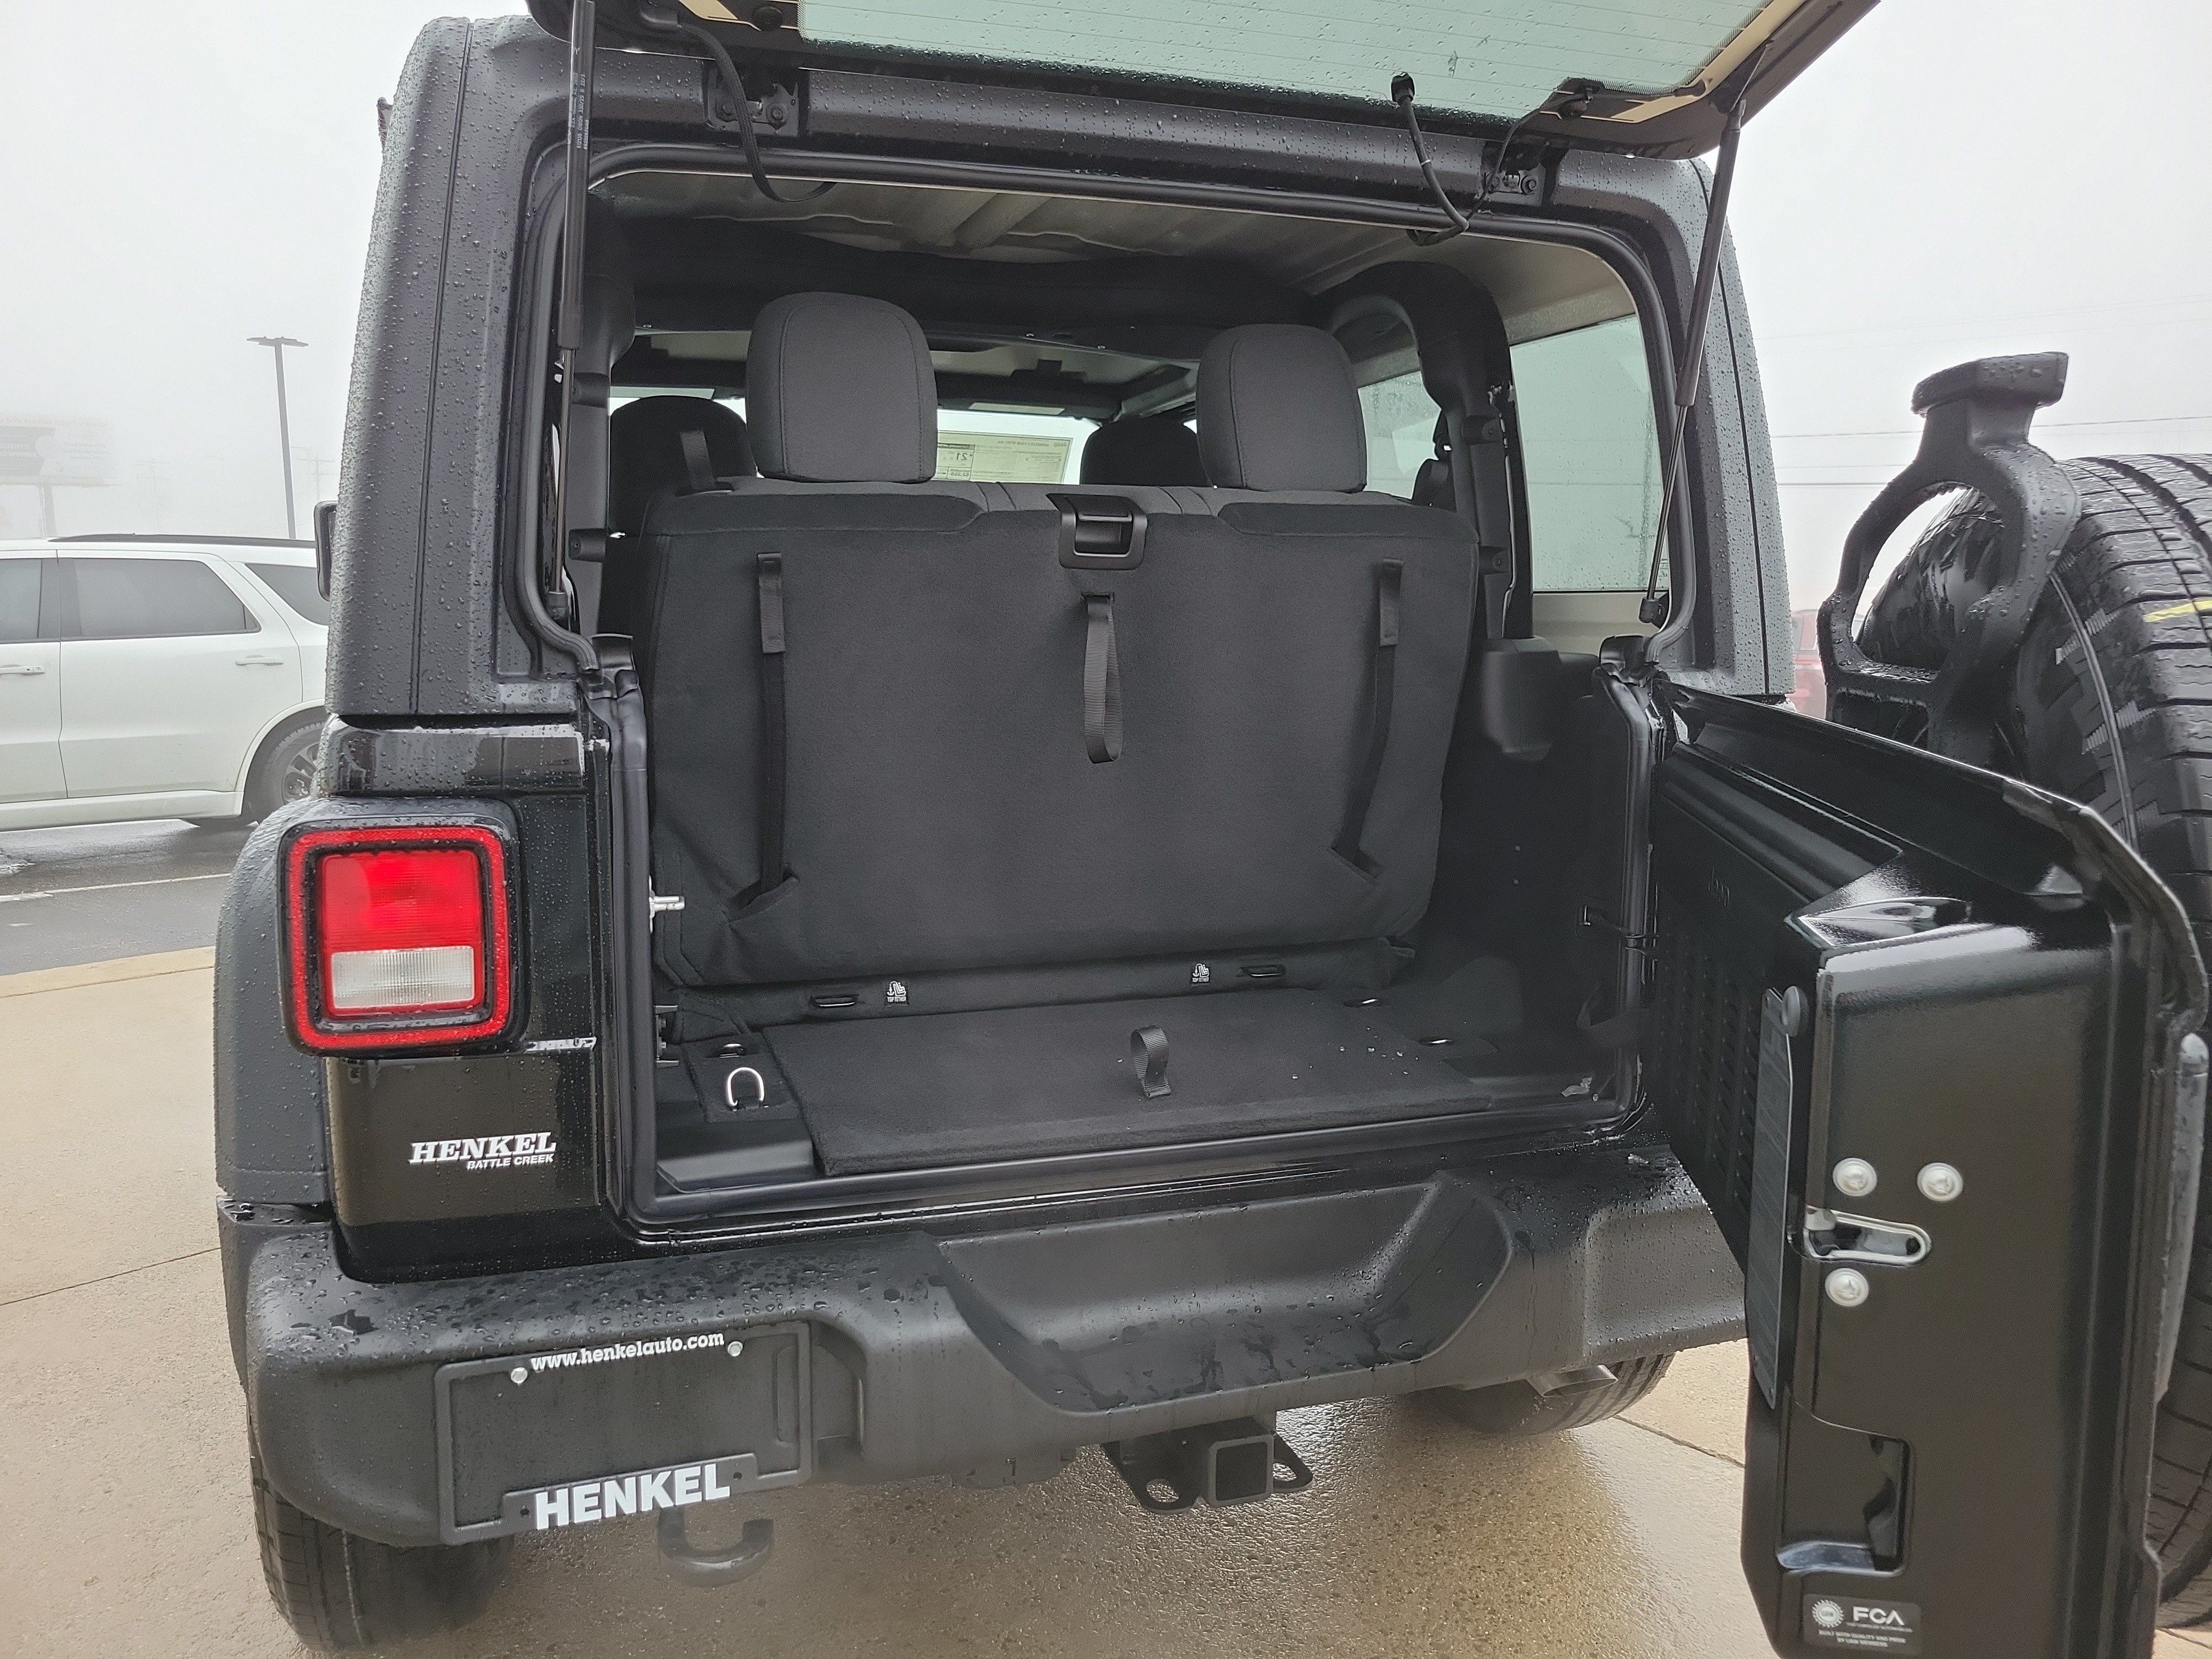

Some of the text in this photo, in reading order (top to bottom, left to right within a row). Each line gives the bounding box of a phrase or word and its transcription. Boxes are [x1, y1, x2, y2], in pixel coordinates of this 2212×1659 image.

[408, 1132, 557, 1164] HENKEL
[466, 1153, 555, 1170] BATTLE CREEK
[531, 1332, 725, 1372] www.henkelauto.com
[535, 1463, 730, 1531] HENKEL
[1853, 1605, 1906, 1626] FCA
